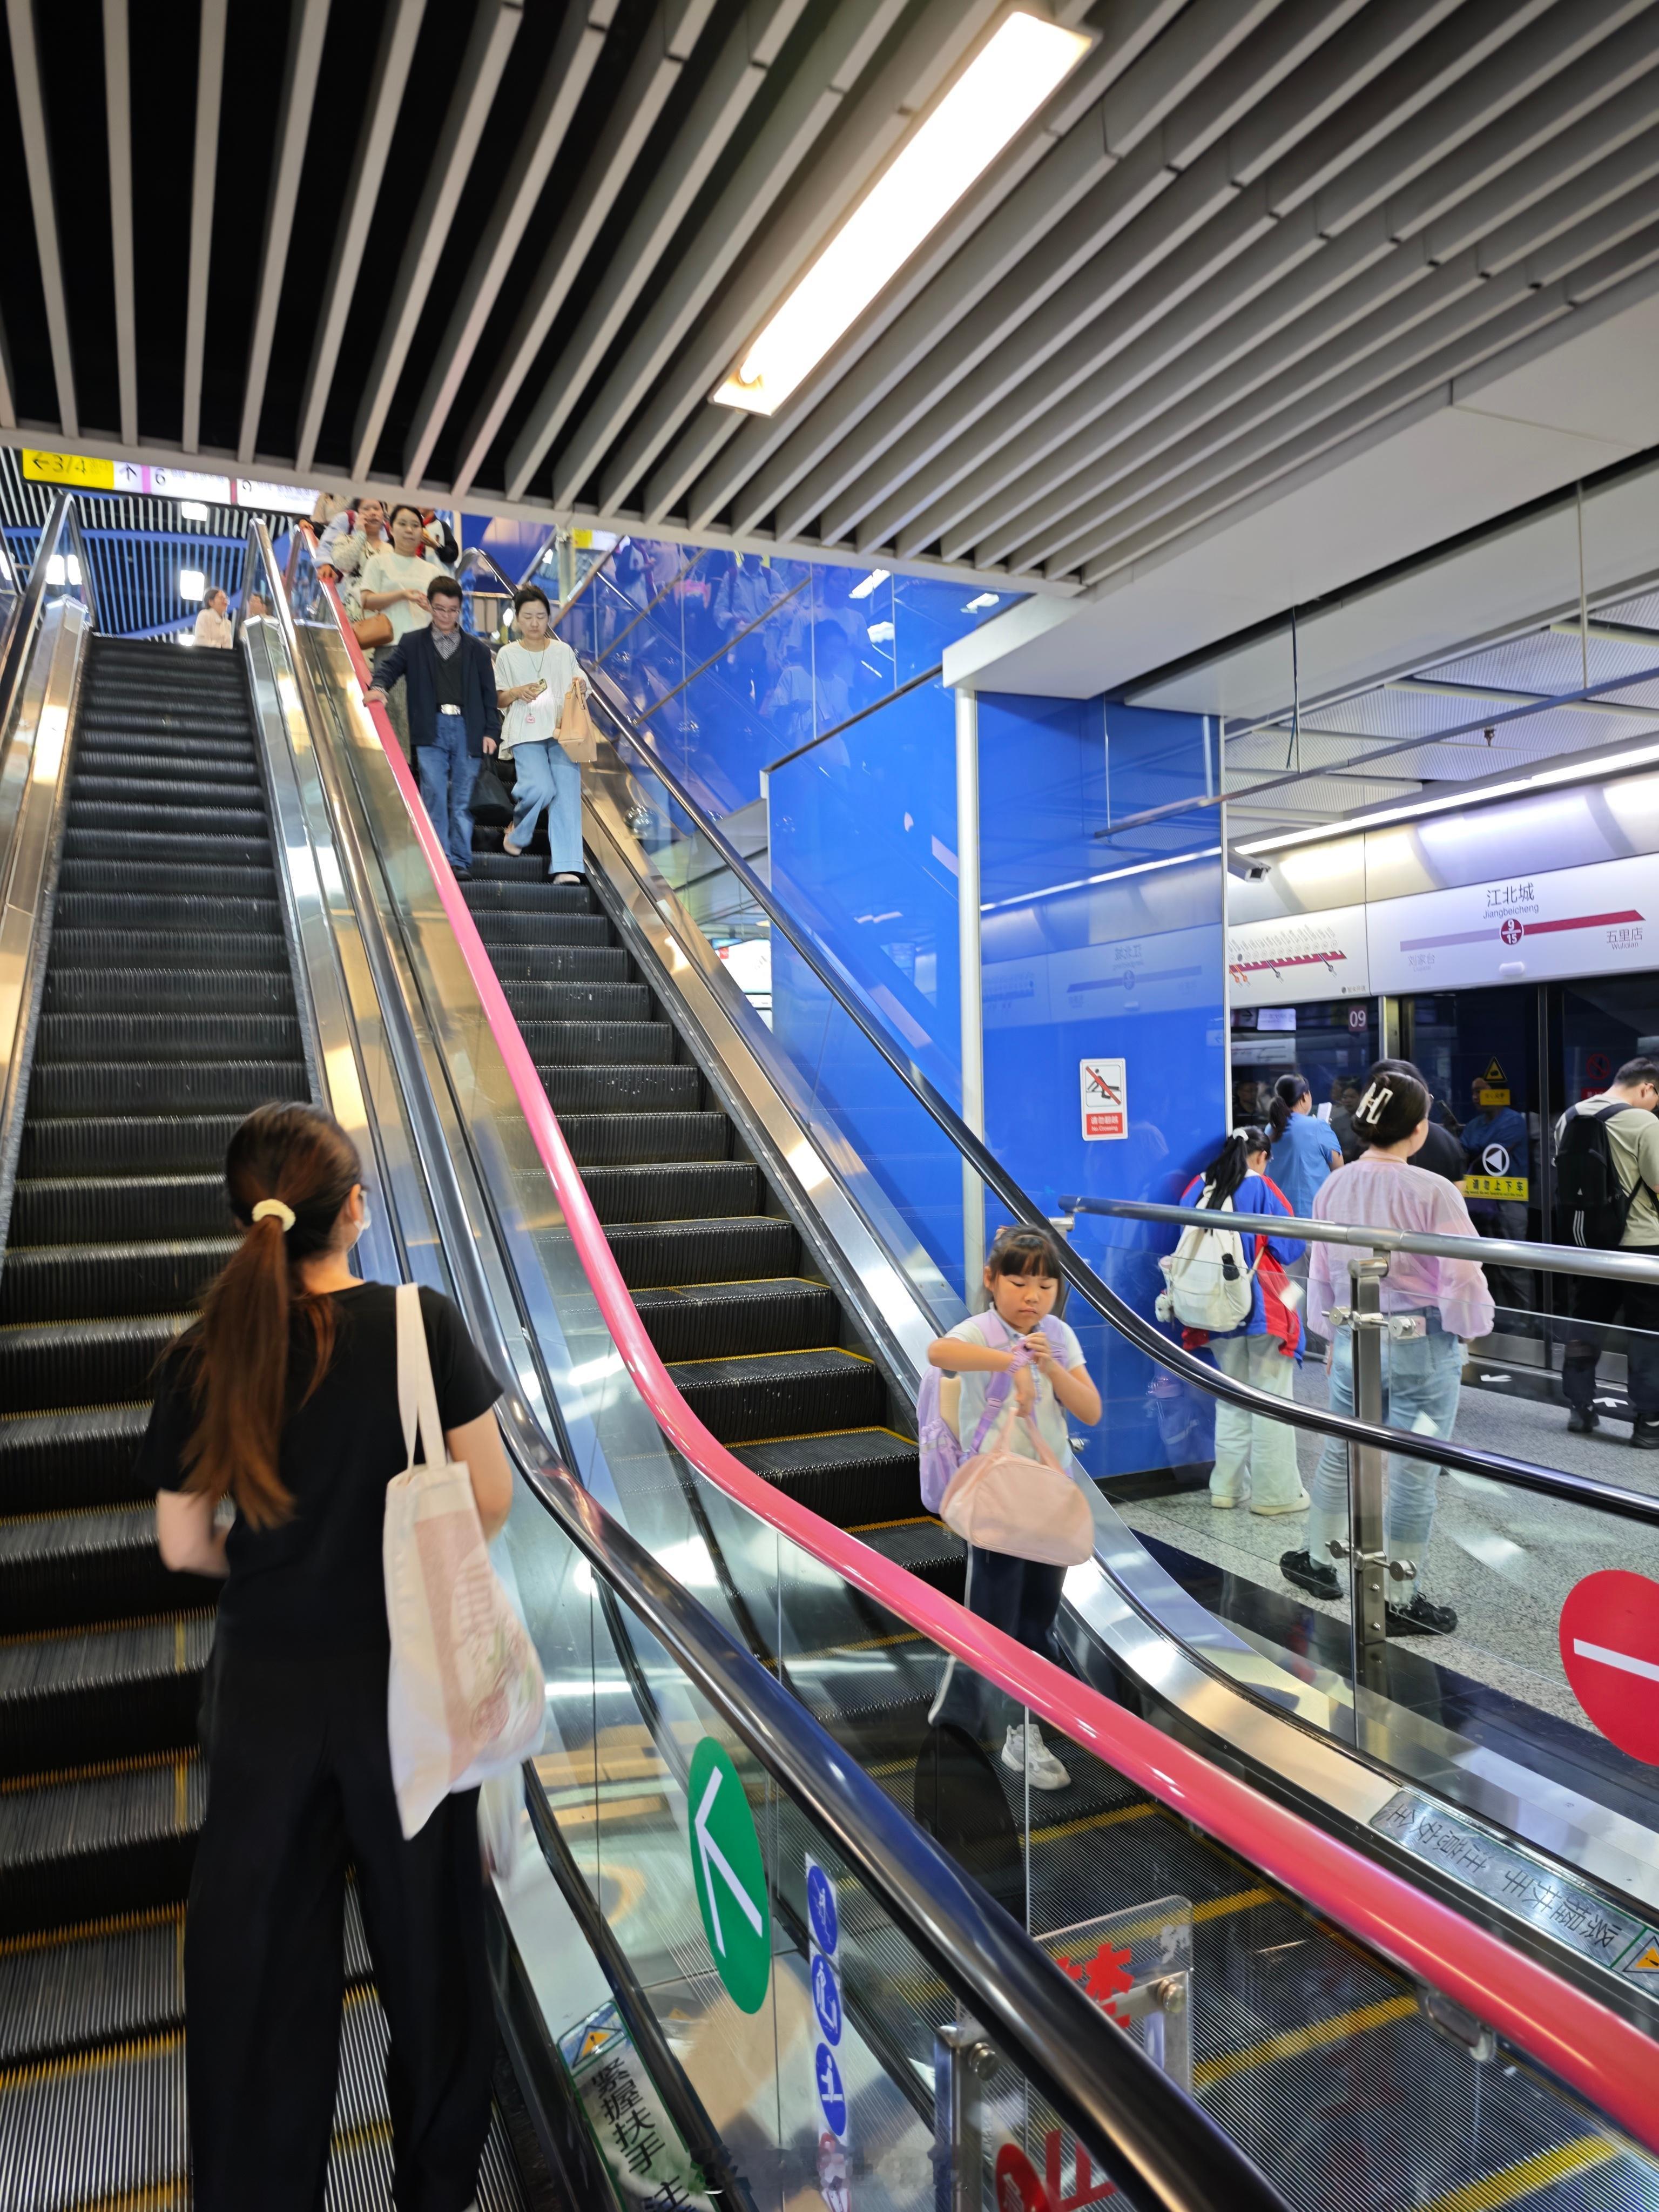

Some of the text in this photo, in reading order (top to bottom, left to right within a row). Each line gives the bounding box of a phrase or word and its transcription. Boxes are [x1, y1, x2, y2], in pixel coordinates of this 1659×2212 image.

[154, 468, 166, 486] 6
[1486, 882, 1534, 907] 江北城
[1483, 904, 1539, 919] Jiangbeicheng
[1507, 920, 1515, 931] 9
[1506, 934, 1518, 944] 15
[1606, 927, 1643, 943] 五里店
[1611, 942, 1638, 950] Wulidian
[1350, 1010, 1366, 1027] 09
[1473, 1179, 1523, 1192] 请勿上下车
[1388, 1803, 1622, 1948] 紧握扶手 注意安全
[591, 2056, 665, 2175] 紧握扶手
